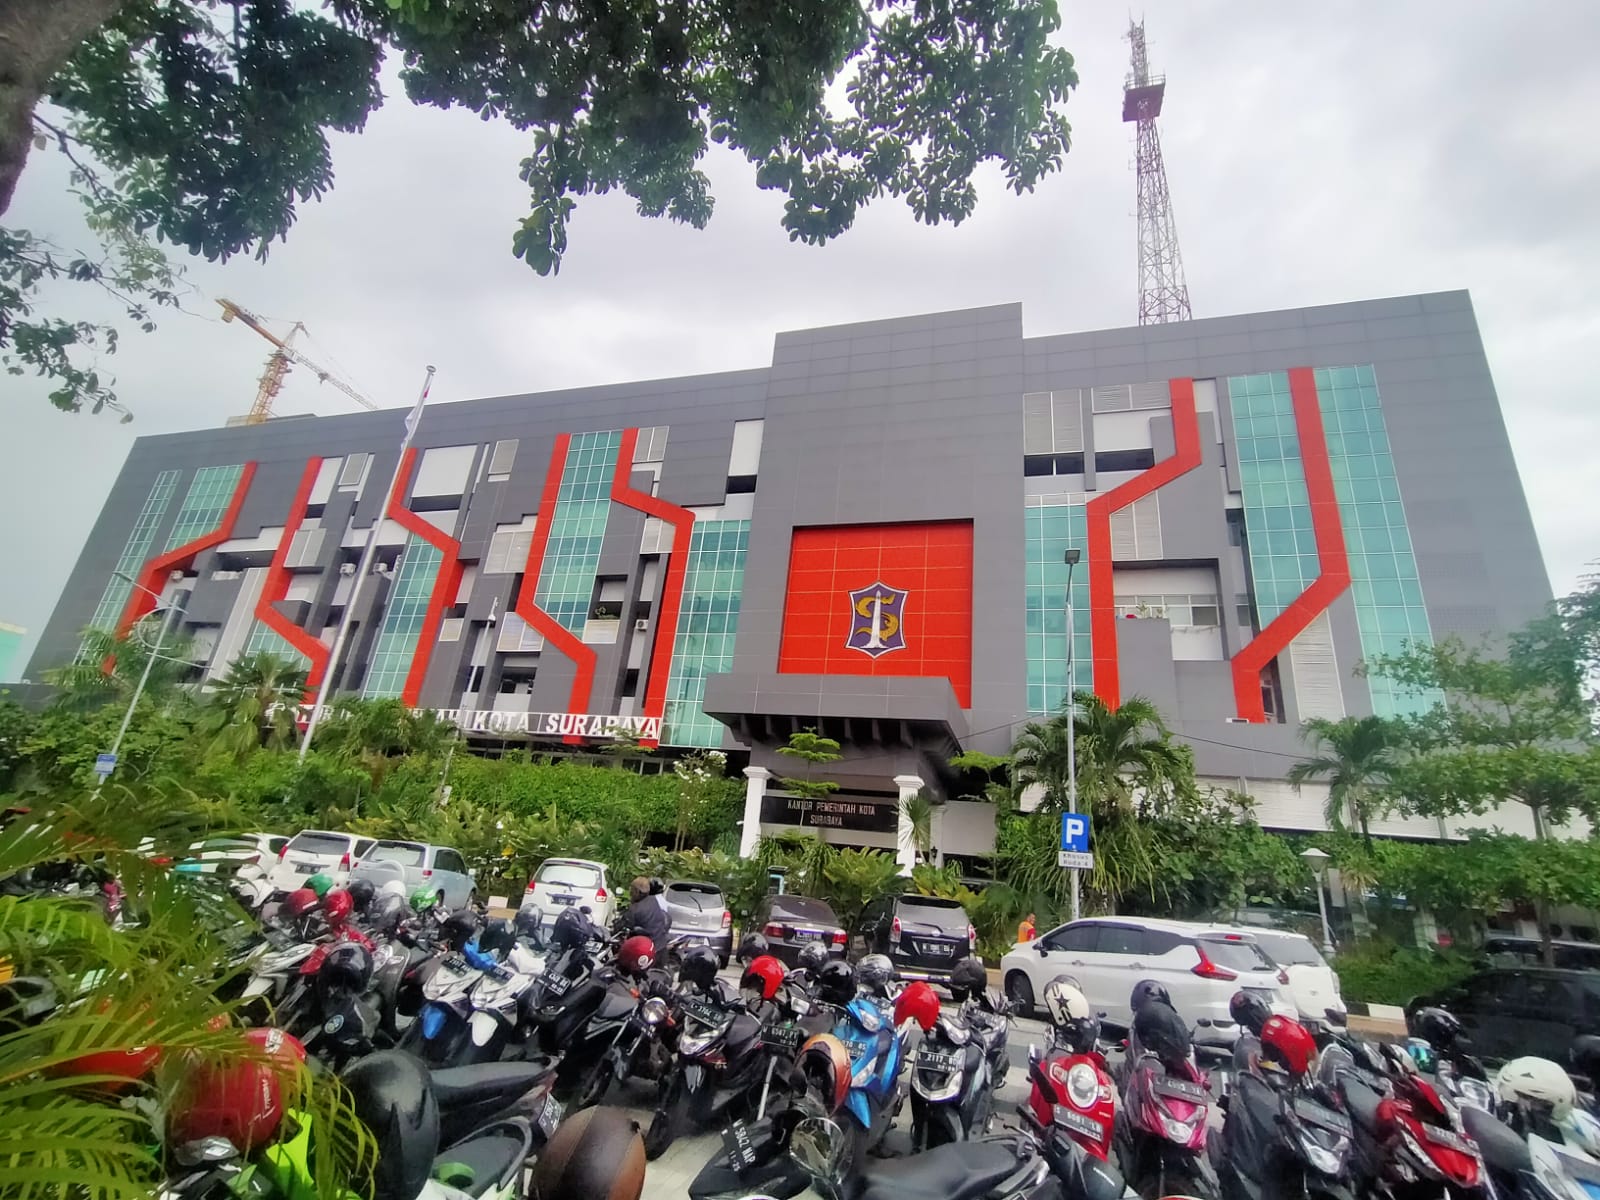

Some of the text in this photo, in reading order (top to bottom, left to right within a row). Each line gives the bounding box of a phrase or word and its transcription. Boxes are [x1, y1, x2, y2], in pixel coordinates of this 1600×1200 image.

[471, 710, 530, 733] KOTA
[859, 805, 875, 816] KOTA
[810, 814, 843, 826] SURABAYA
[1065, 818, 1084, 844] P
